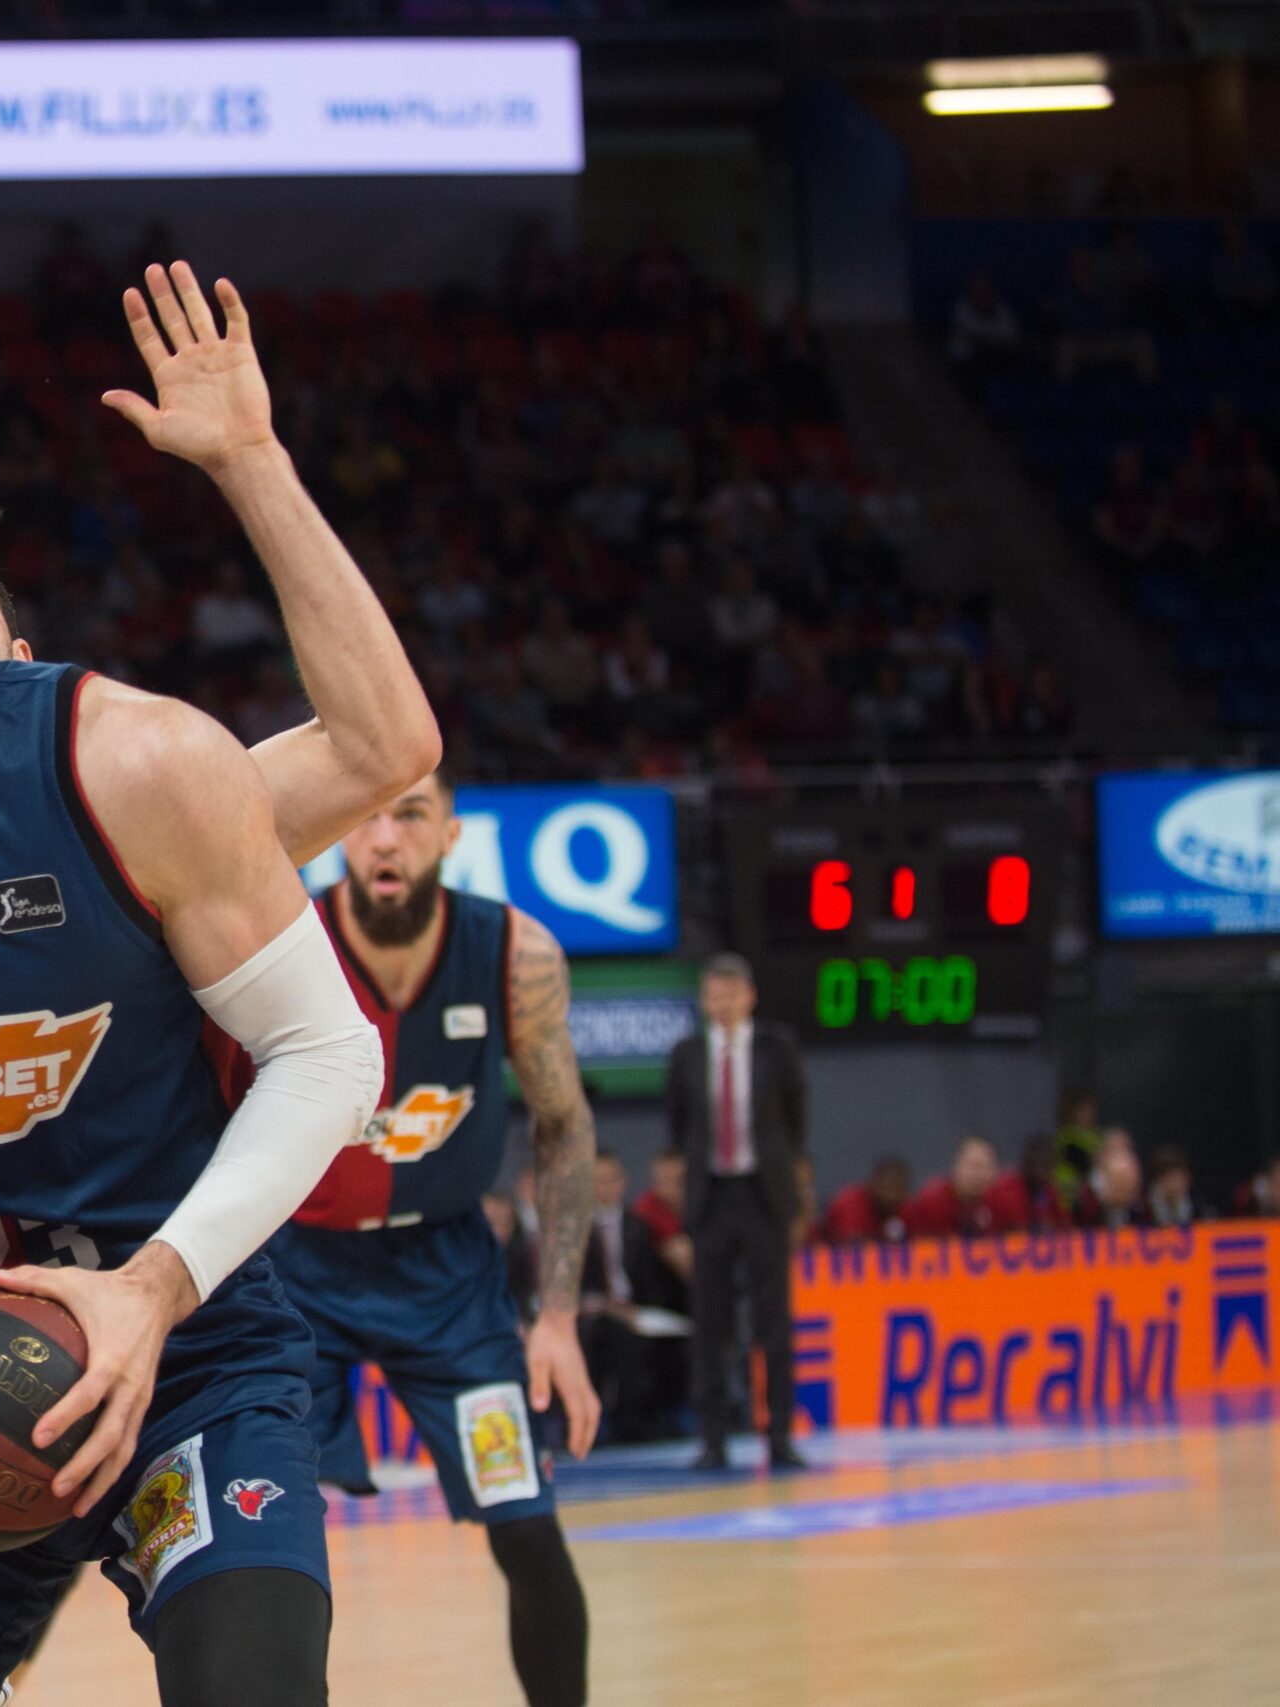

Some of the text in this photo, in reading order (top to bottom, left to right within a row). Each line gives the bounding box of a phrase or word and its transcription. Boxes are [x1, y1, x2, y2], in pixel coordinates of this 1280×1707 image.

[14, 904, 61, 918] endesa
[811, 861, 852, 930] 6
[987, 856, 1030, 925] 0
[817, 955, 976, 1027] 07:00
[27, 1087, 60, 1110] .es
[880, 1288, 1180, 1426] Recalvi
